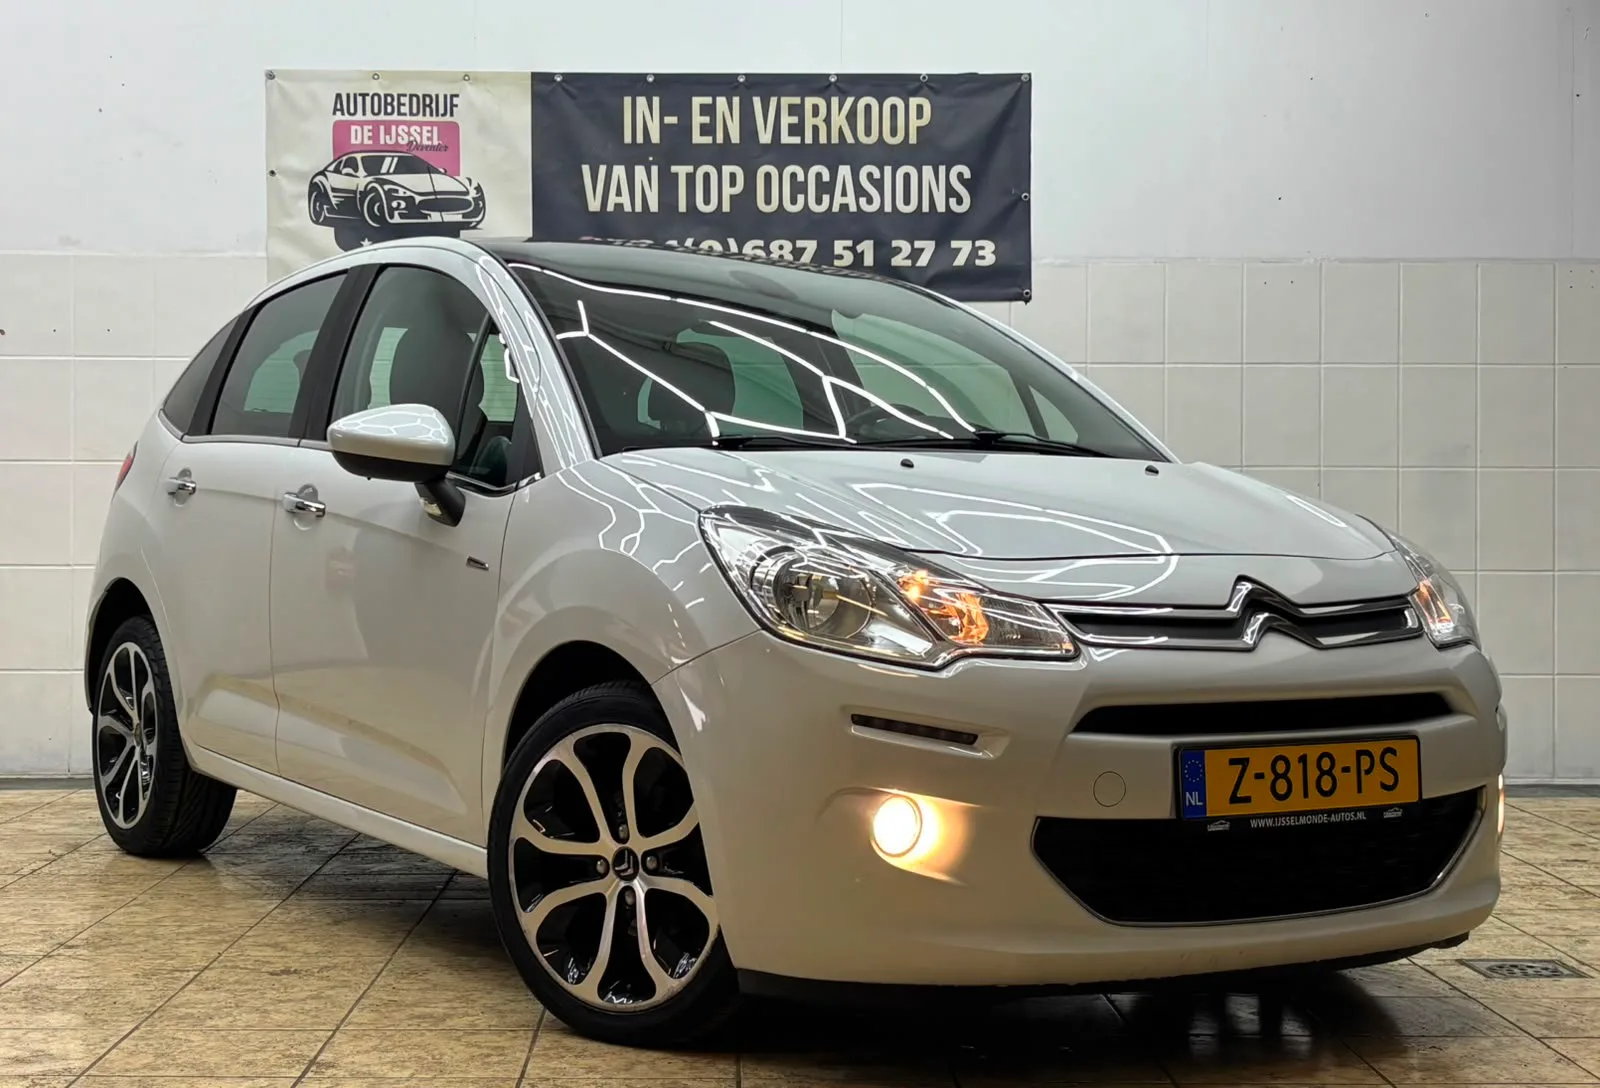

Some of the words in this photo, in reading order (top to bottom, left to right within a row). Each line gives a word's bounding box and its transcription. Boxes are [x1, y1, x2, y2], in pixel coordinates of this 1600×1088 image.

[332, 92, 460, 117] AUTOBEDRIJF
[623, 96, 678, 144] IN-
[691, 96, 740, 144] EN
[752, 96, 932, 145] VERKOOP
[350, 125, 373, 145] DE
[380, 125, 443, 145] IJSSEL
[406, 140, 449, 152] Deventer
[581, 164, 659, 213] VAN
[670, 164, 745, 213] TOP
[756, 164, 972, 213] OCCASIONS
[833, 239, 874, 267] 51
[890, 239, 936, 267] 27
[950, 239, 997, 267] 73
[1228, 746, 1400, 804] Z-818-PS
[1185, 791, 1203, 806] NL
[1249, 812, 1367, 828] WWW.IJSSELMONDE-AUTOS.NL
